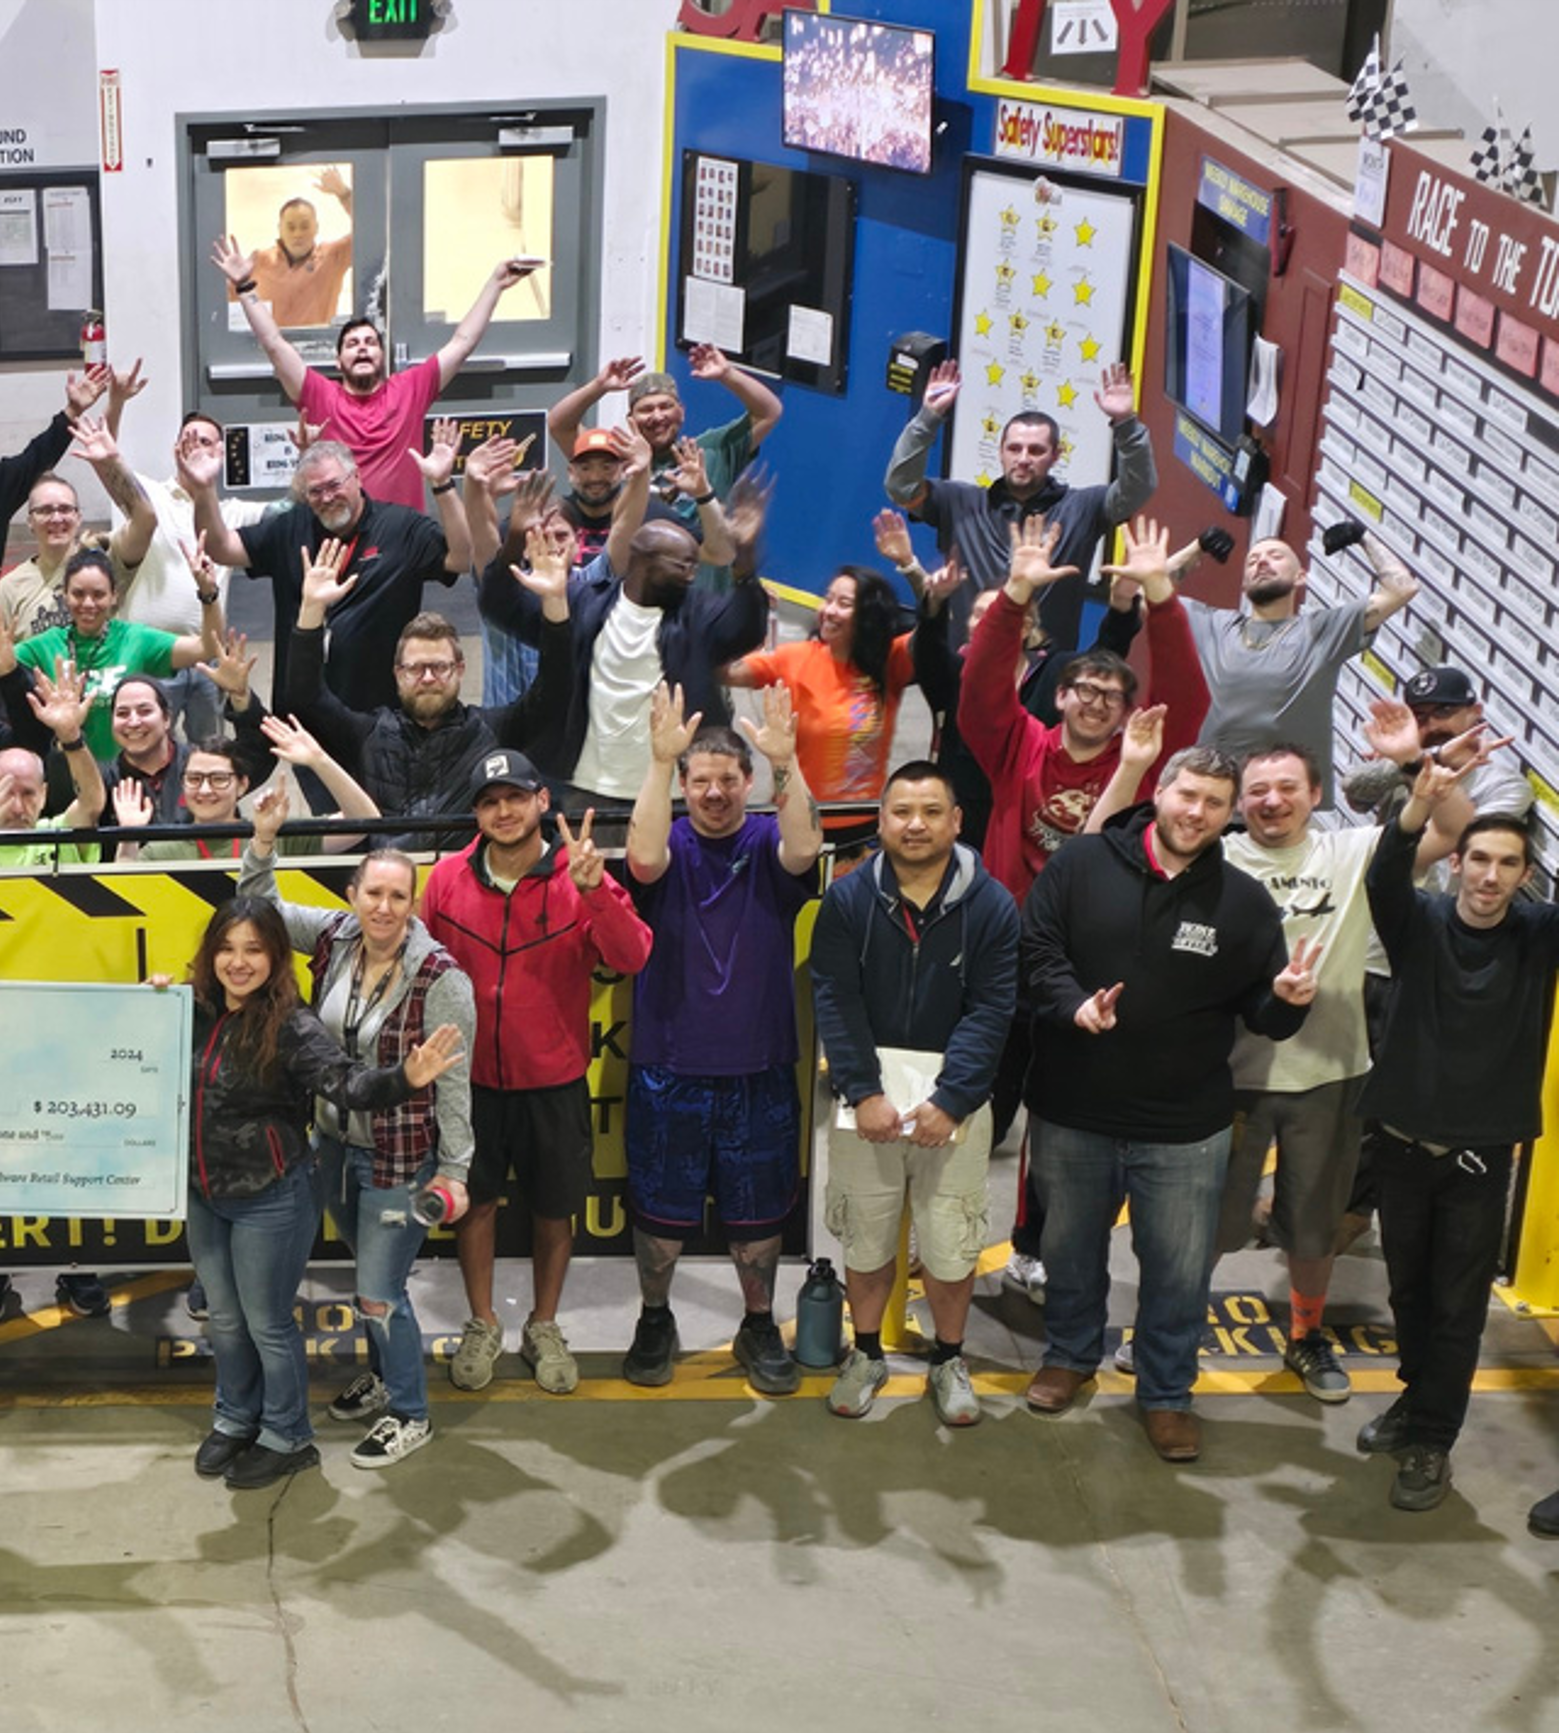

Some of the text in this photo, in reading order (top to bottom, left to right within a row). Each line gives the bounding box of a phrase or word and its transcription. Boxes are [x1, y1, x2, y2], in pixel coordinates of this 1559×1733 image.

[998, 104, 1121, 161] Safety Superstars!
[1407, 170, 1466, 258] RACE
[1463, 218, 1490, 274] TO
[1492, 232, 1528, 295] THE
[1529, 235, 1559, 321] TO
[1267, 876, 1333, 891] AMENTO
[110, 1049, 144, 1061] 2024
[33, 1100, 137, 1118] $ 203,431.09
[18, 1129, 40, 1140] and
[30, 1172, 60, 1185] Retail
[62, 1172, 104, 1188] Support
[106, 1174, 141, 1187] Center
[1207, 1295, 1271, 1325] O
